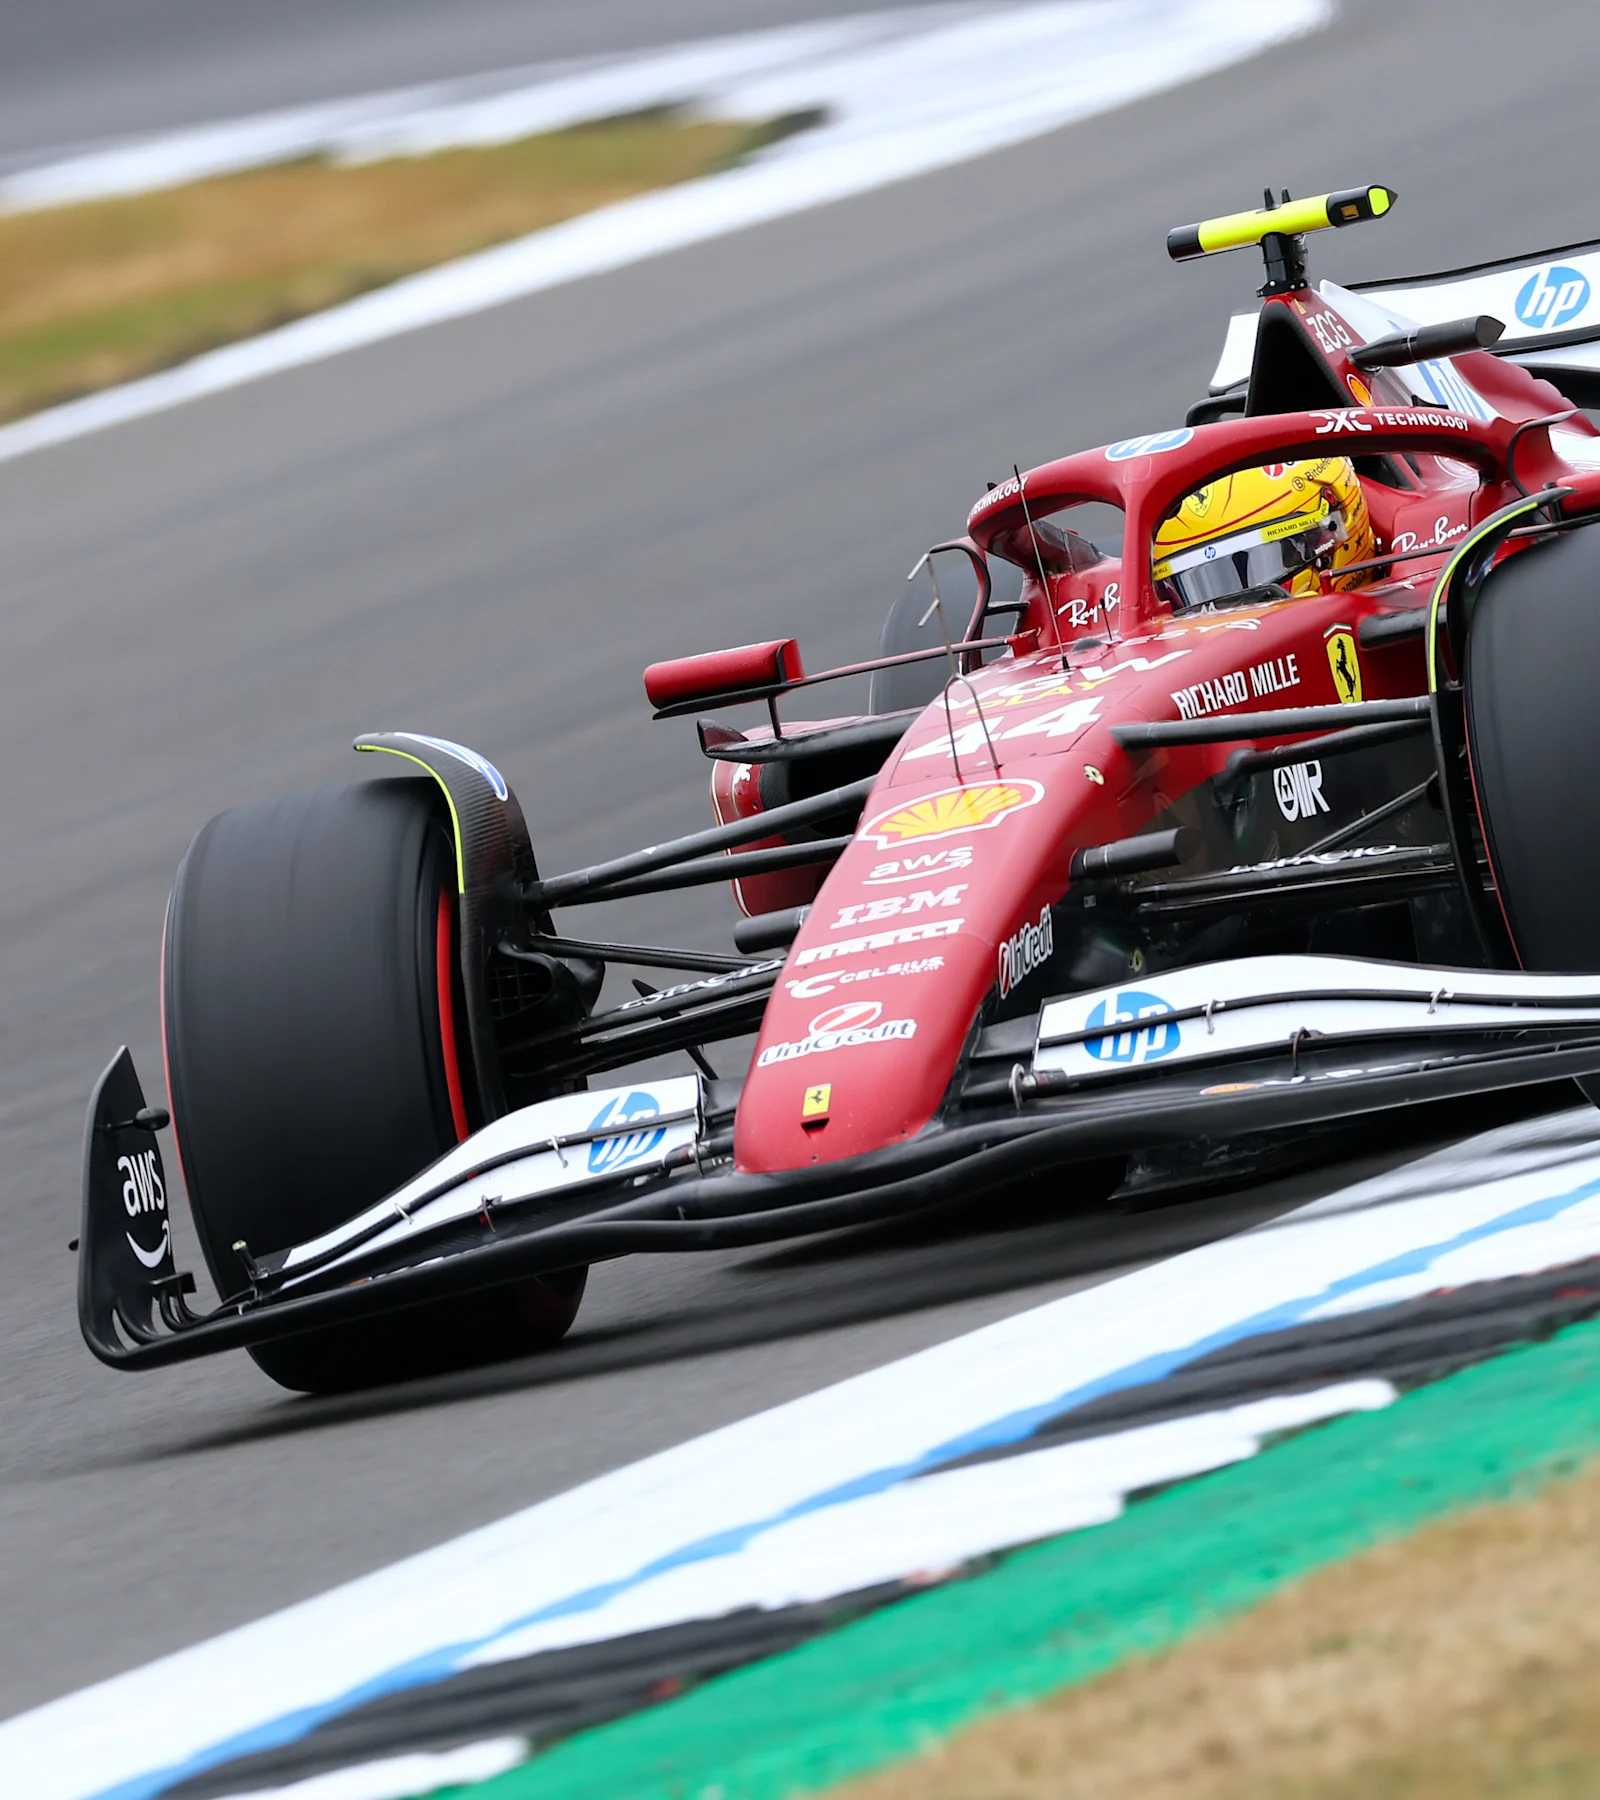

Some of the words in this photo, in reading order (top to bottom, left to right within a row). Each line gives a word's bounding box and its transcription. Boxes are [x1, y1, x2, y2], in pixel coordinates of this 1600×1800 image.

[1520, 267, 1587, 329] hp
[1306, 310, 1352, 354] ZCG
[1309, 410, 1373, 434] DXC
[1373, 412, 1469, 432] TECHNOLOGY
[1266, 523, 1298, 536] RICHARD
[1204, 547, 1216, 559] hp
[1170, 671, 1249, 720] RICHARD
[1249, 654, 1301, 698] MILLE
[901, 696, 1105, 761] 44
[869, 846, 974, 878] aws
[829, 883, 969, 930] IBM
[839, 956, 945, 984] CELSIUS
[761, 1020, 914, 1064] UniCredit
[1099, 993, 1170, 1063] hp
[594, 1092, 662, 1173] hp
[116, 1148, 166, 1217] aws
